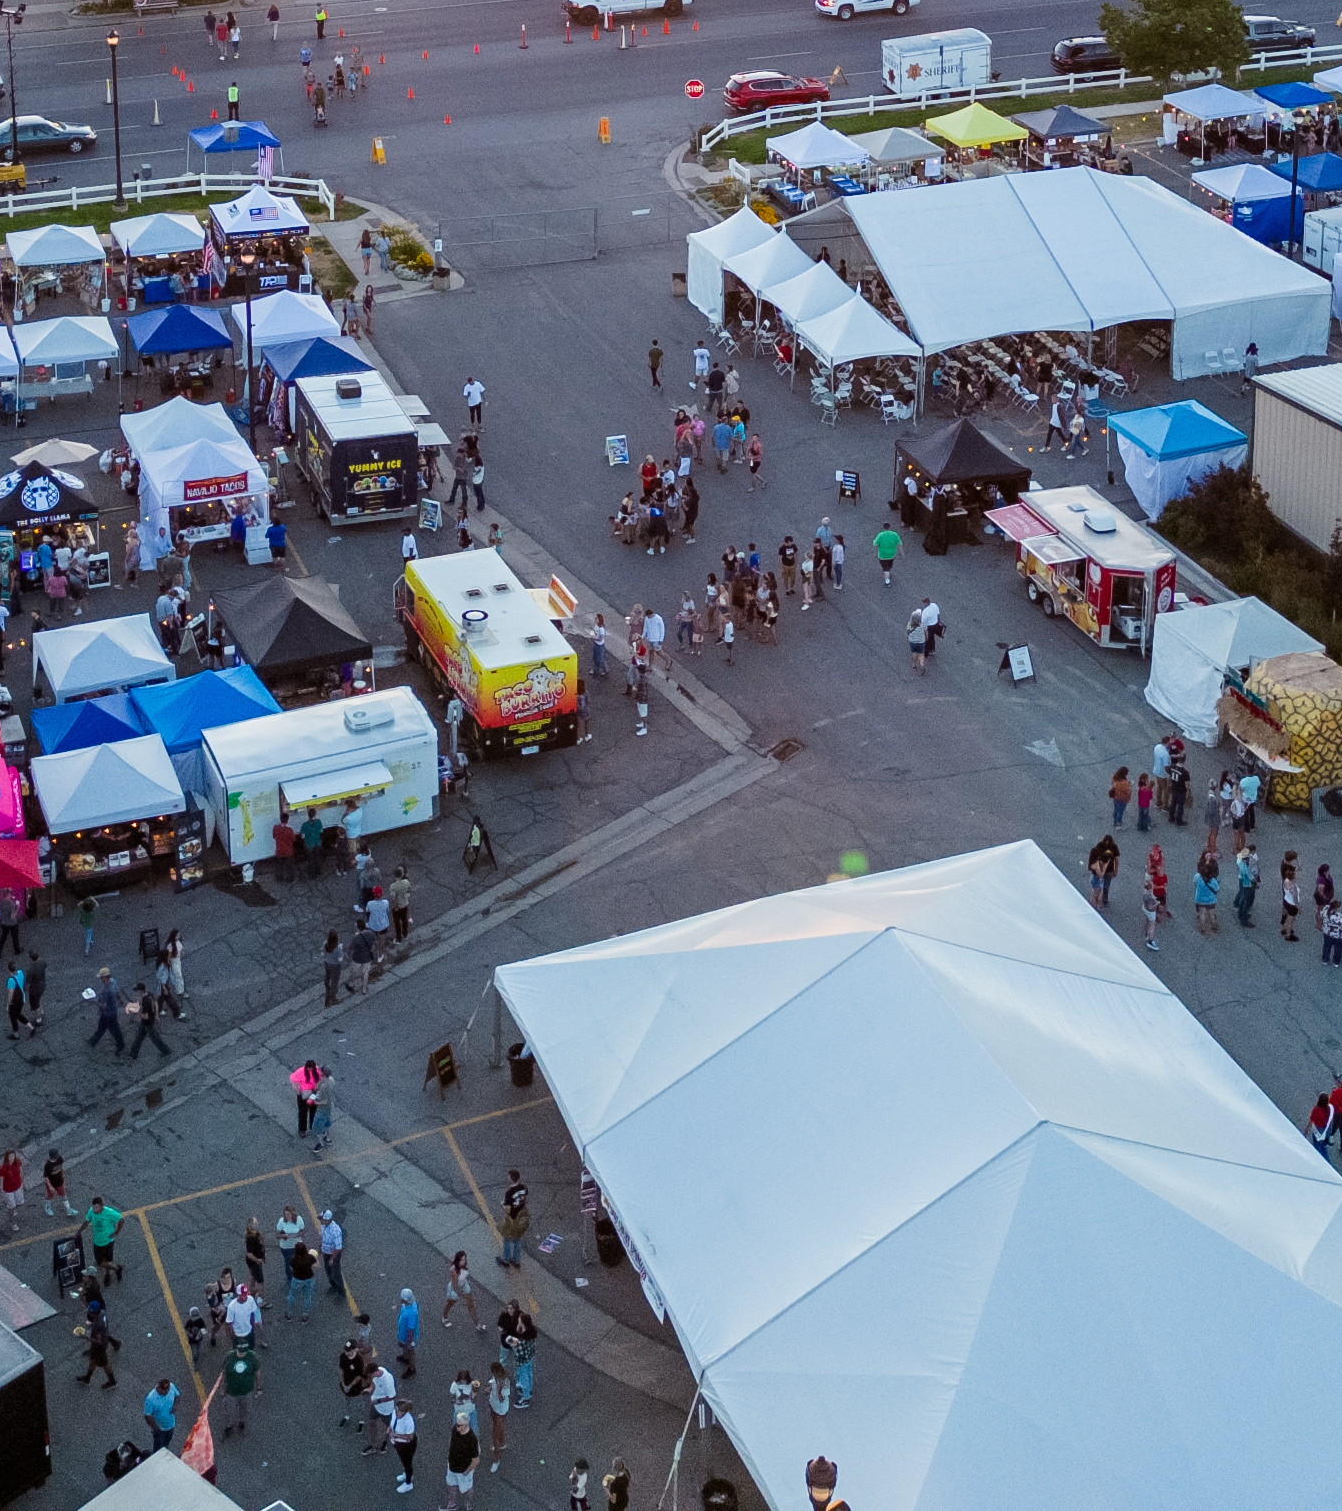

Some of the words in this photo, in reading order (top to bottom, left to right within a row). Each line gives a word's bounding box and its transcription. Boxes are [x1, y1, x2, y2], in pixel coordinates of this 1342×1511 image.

[685, 83, 704, 94] STOP
[349, 461, 384, 473] YUMMY
[386, 459, 402, 469] ICE
[187, 484, 217, 498] NAVAJO
[220, 480, 245, 493] TACOS
[494, 679, 533, 705] TACO
[501, 682, 566, 717] BURRITO
